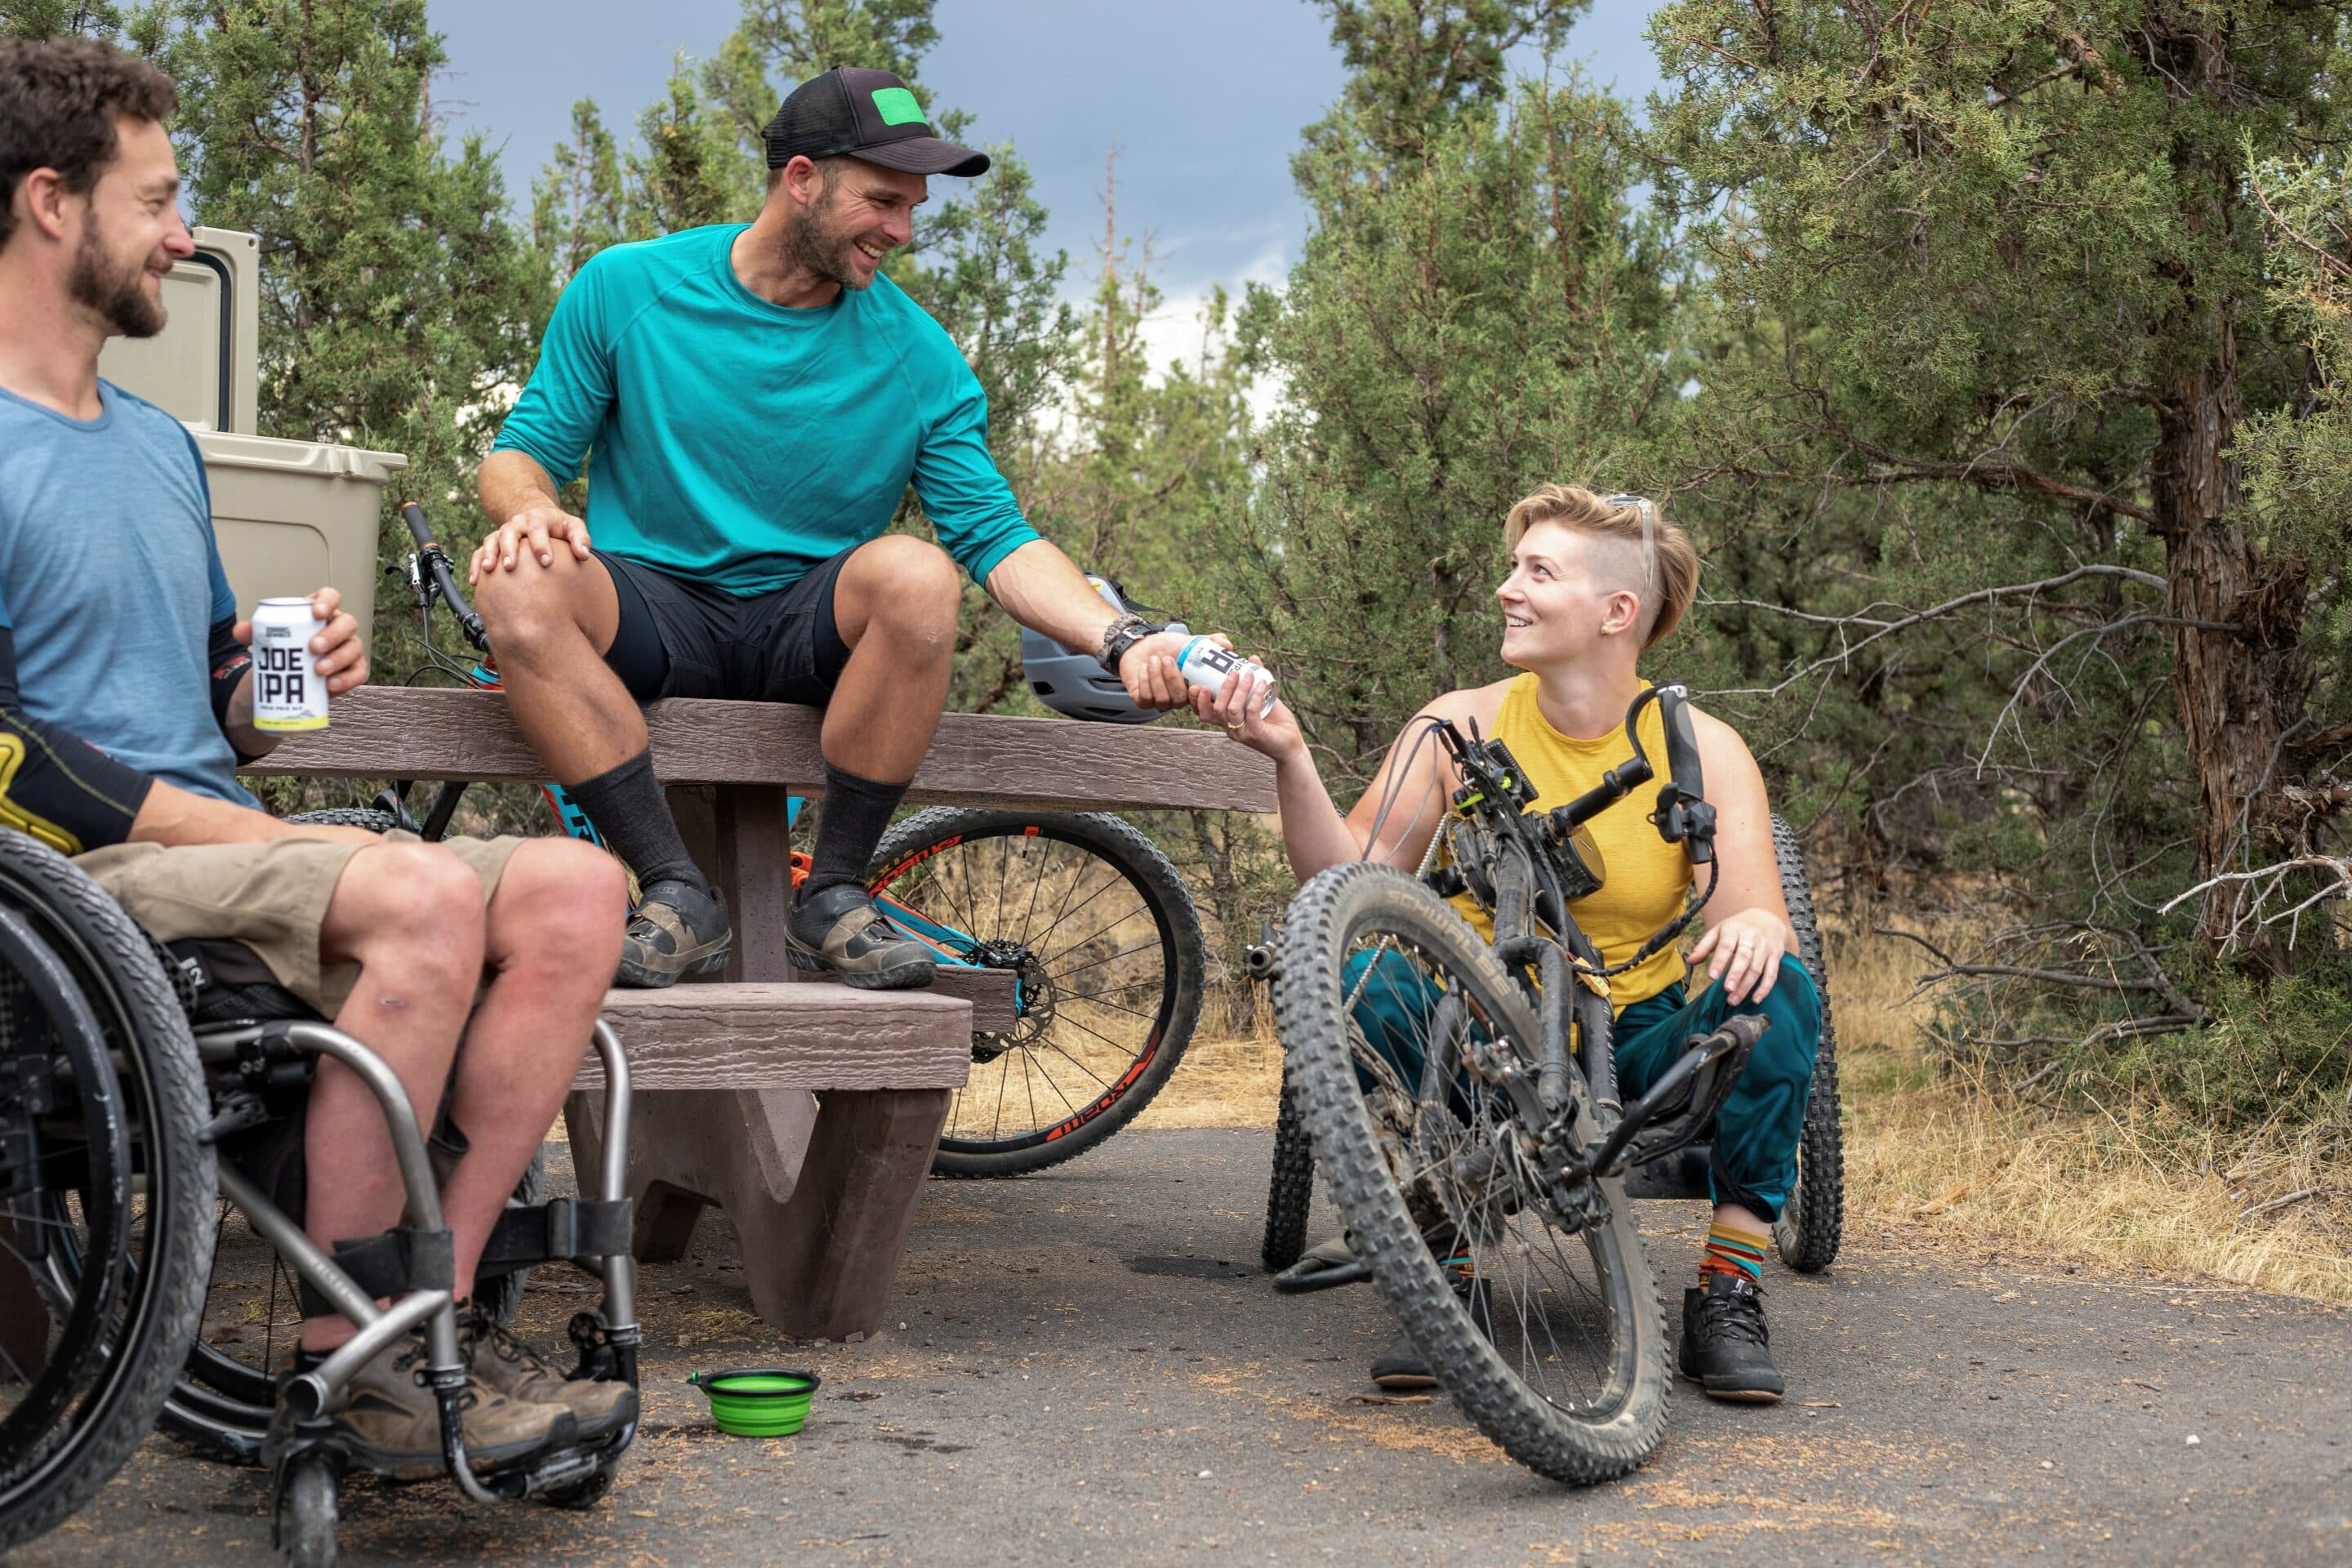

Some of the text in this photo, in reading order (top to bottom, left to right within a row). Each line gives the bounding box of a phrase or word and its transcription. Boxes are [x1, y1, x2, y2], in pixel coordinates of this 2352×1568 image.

[258, 648, 303, 671] JOE
[258, 674, 304, 703] IPA
[1388, 889, 1511, 997] SCHWALBE
